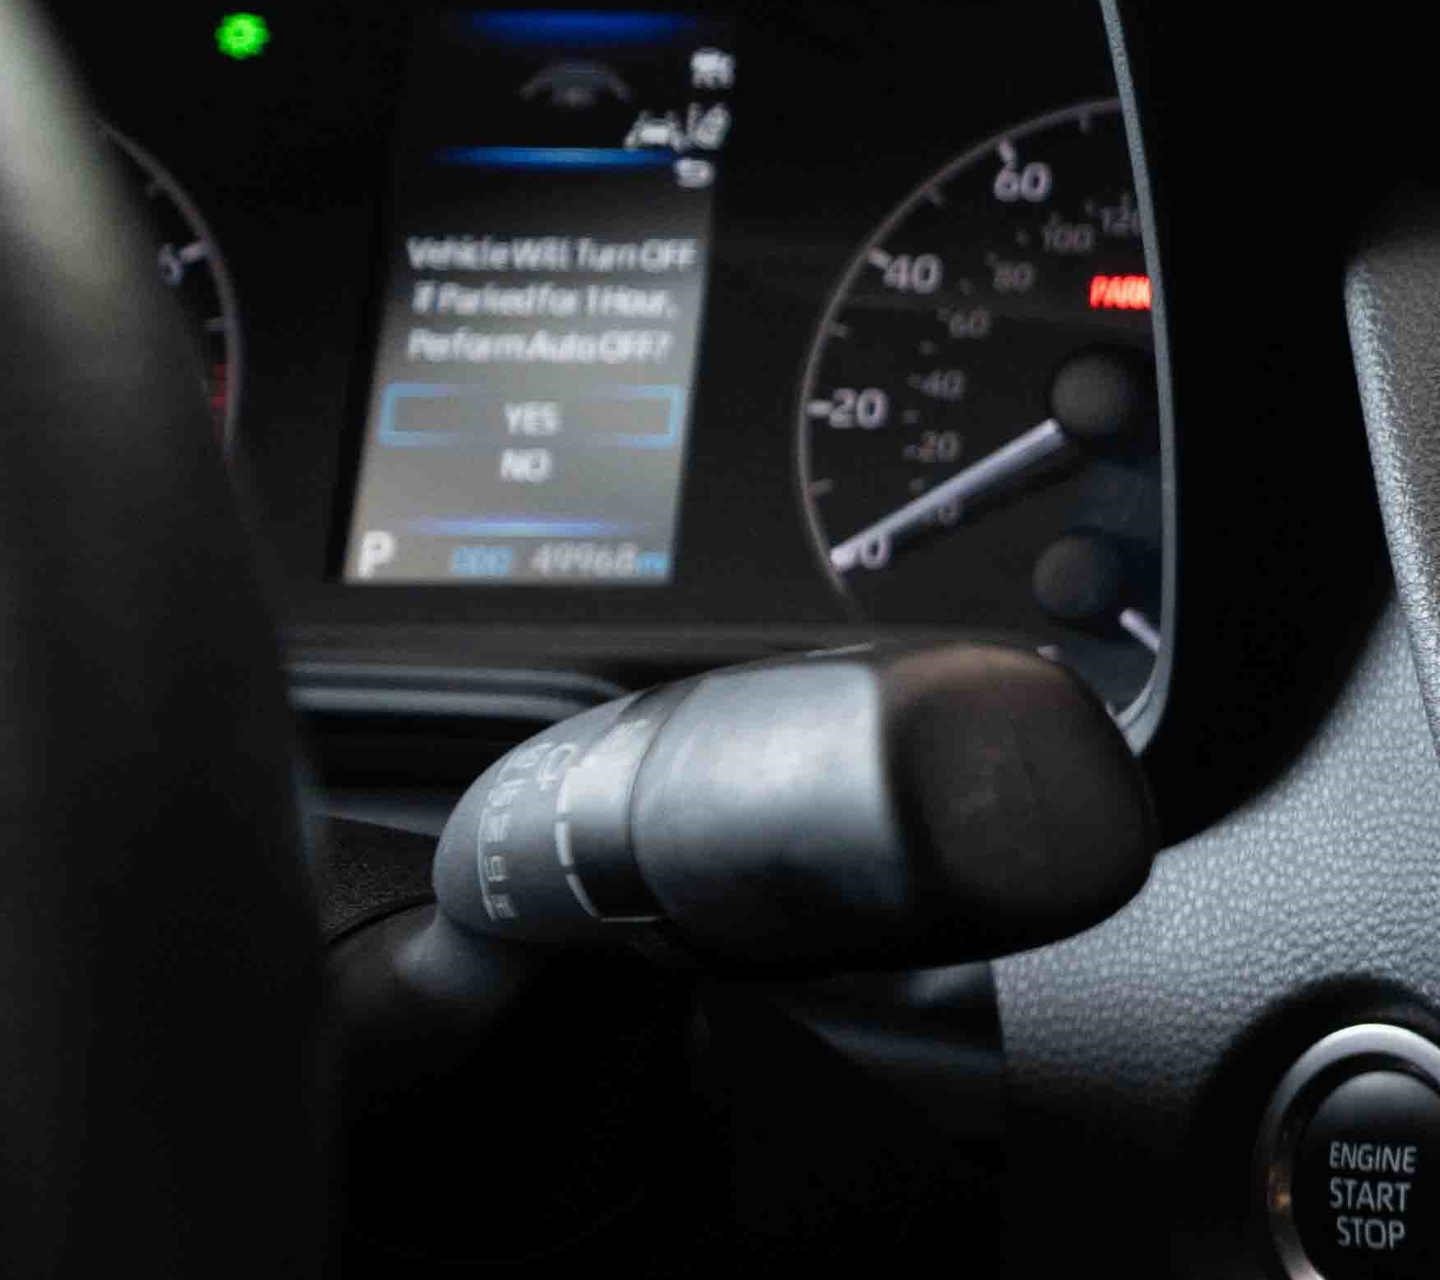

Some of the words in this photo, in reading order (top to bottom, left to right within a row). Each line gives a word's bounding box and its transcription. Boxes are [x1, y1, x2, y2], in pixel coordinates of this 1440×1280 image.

[993, 161, 1051, 202] 60
[406, 235, 510, 270] Vehicle
[576, 236, 640, 271] Turn
[640, 238, 698, 272] OFF
[883, 254, 943, 294] 40
[407, 326, 526, 363] Perform
[526, 328, 598, 363] Auto
[503, 400, 560, 436] YES
[829, 387, 888, 430] 20
[499, 447, 552, 482] NO
[357, 530, 396, 579] P
[859, 531, 893, 570] 0
[1328, 1140, 1417, 1175] ENGINE
[1328, 1177, 1412, 1213] START
[1336, 1215, 1406, 1250] STOP
